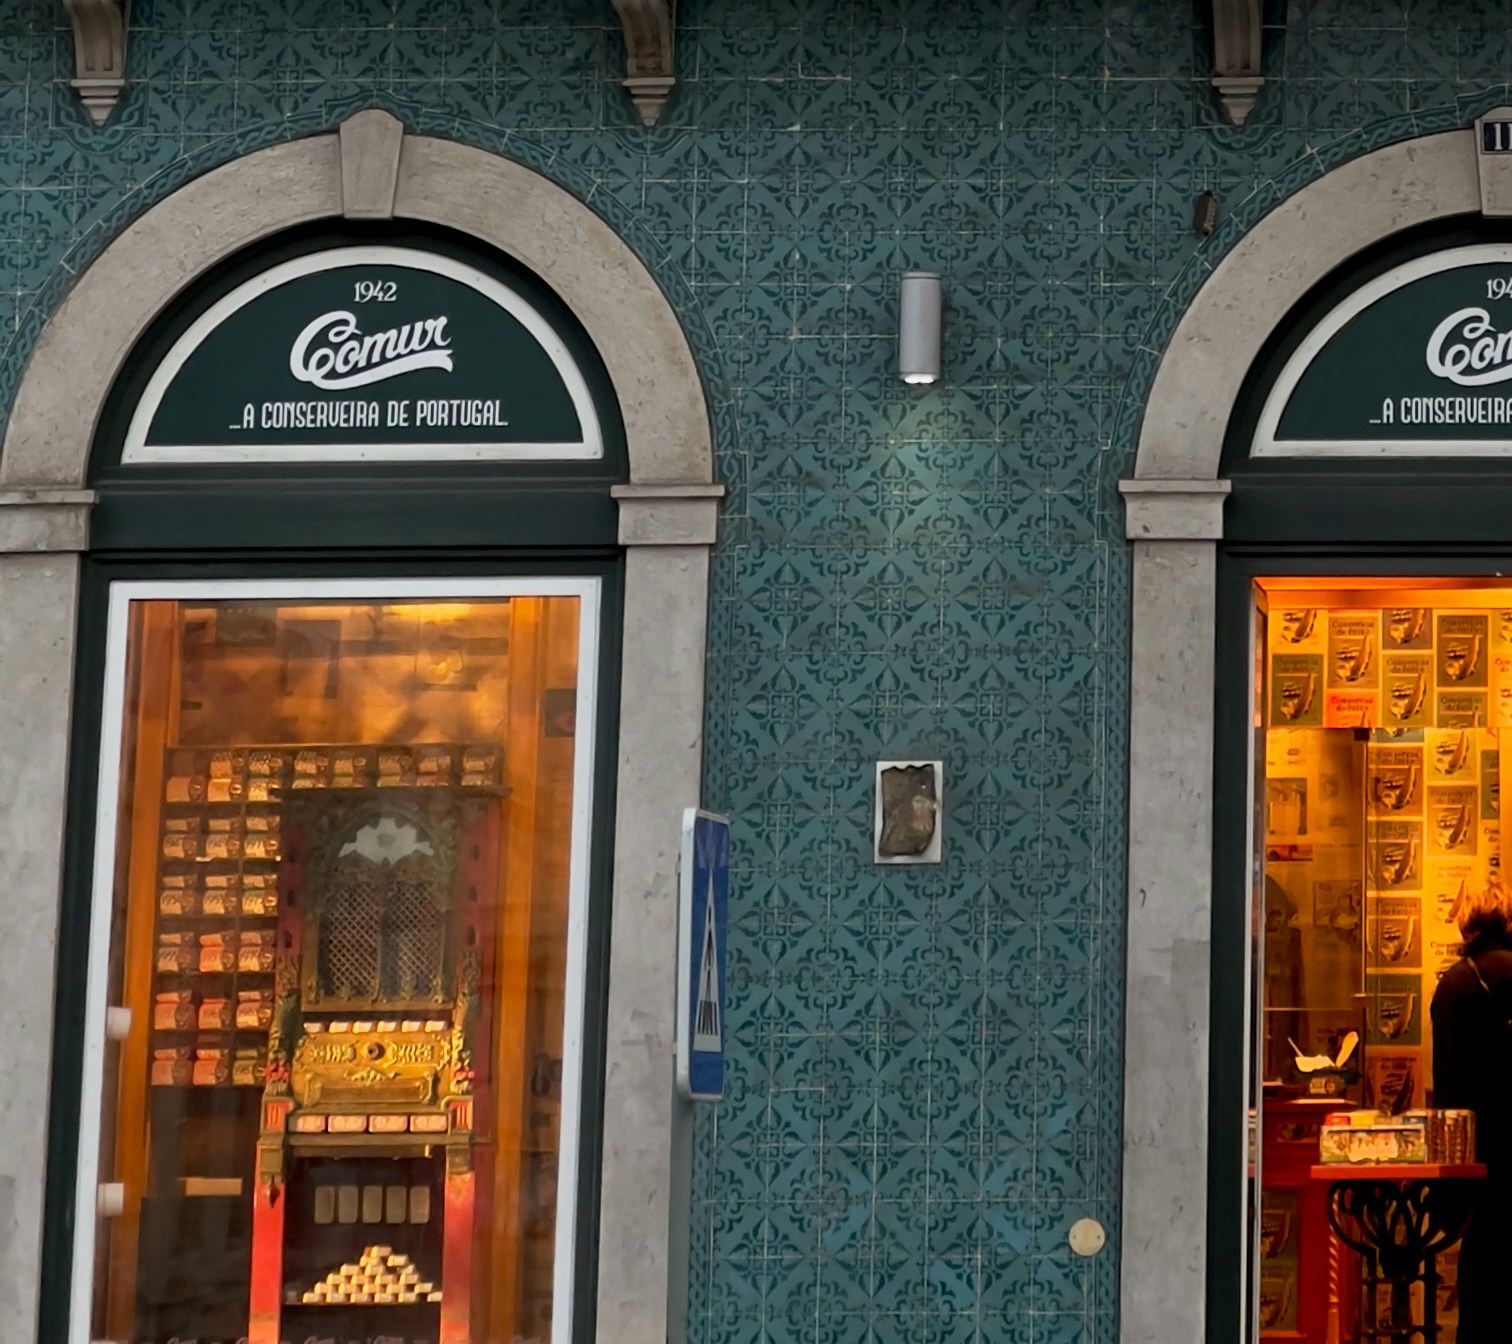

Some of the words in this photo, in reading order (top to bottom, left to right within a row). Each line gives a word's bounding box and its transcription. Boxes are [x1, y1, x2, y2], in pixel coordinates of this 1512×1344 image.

[354, 280, 397, 303] 1942
[290, 310, 453, 391] Comur
[261, 401, 379, 429] CONSERVEIRA
[386, 400, 409, 427] DE
